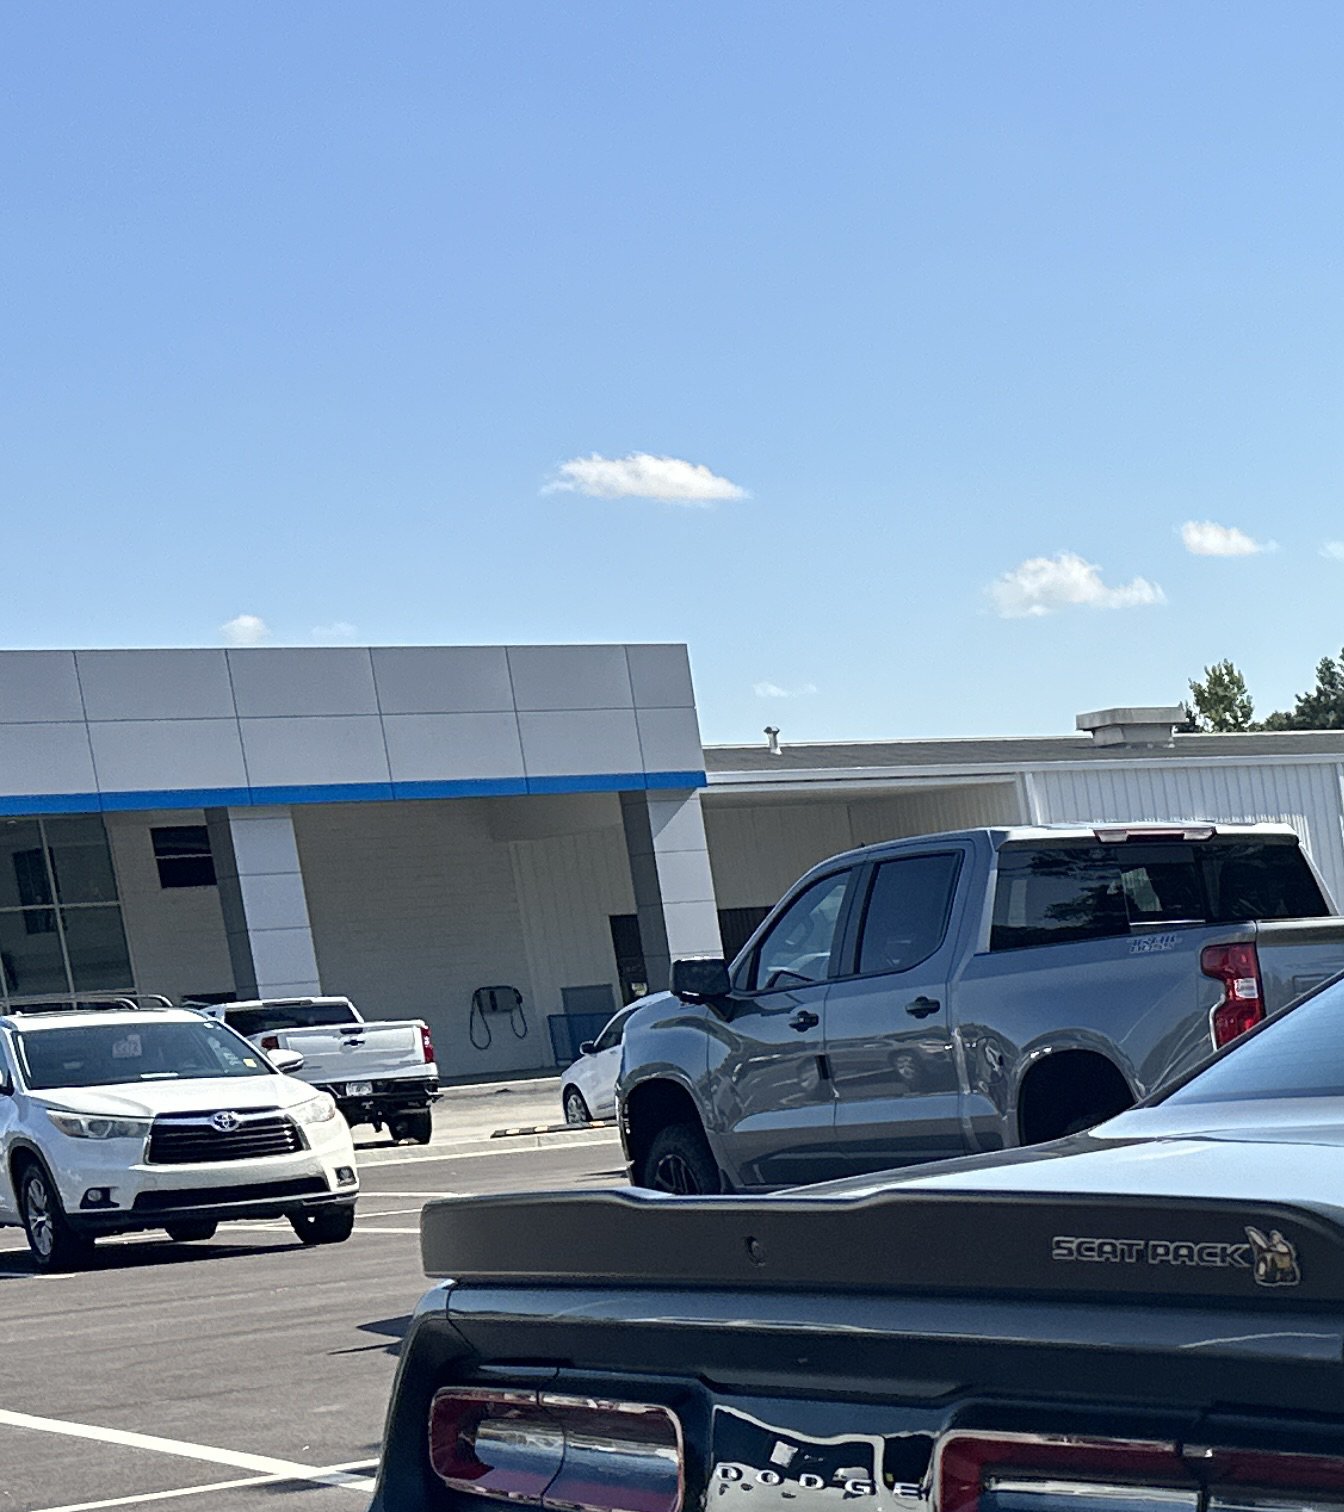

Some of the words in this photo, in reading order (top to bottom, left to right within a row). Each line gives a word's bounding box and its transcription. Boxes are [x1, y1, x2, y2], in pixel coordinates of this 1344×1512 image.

[1052, 1236, 1144, 1263] SCAT
[1149, 1240, 1252, 1267] PACK
[716, 1466, 923, 1501] DODGE
